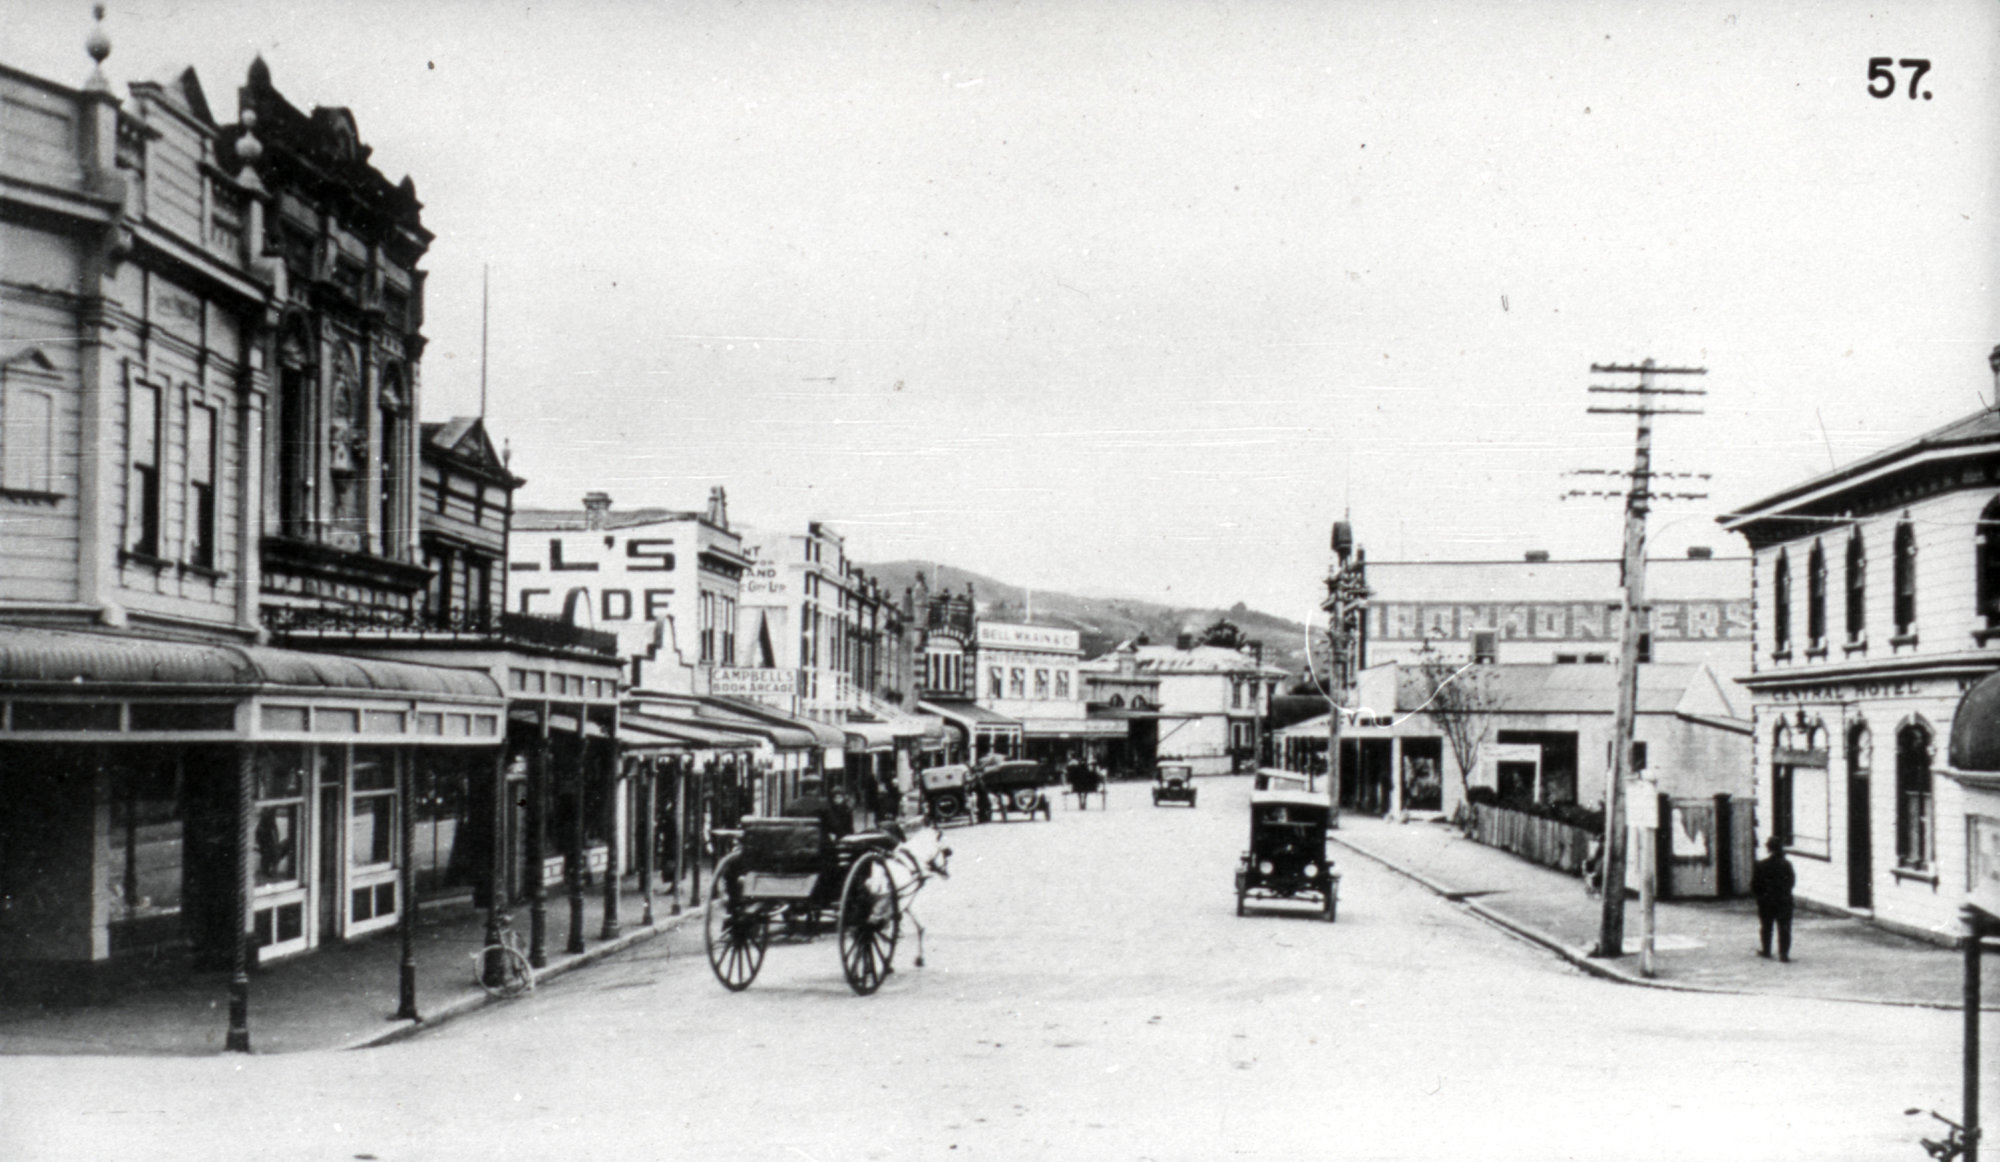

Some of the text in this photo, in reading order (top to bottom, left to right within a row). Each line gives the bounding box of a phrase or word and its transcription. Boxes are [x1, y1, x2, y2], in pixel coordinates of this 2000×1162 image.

[520, 589, 675, 621] CDE
[713, 683, 794, 692] BOOK ARCADE
